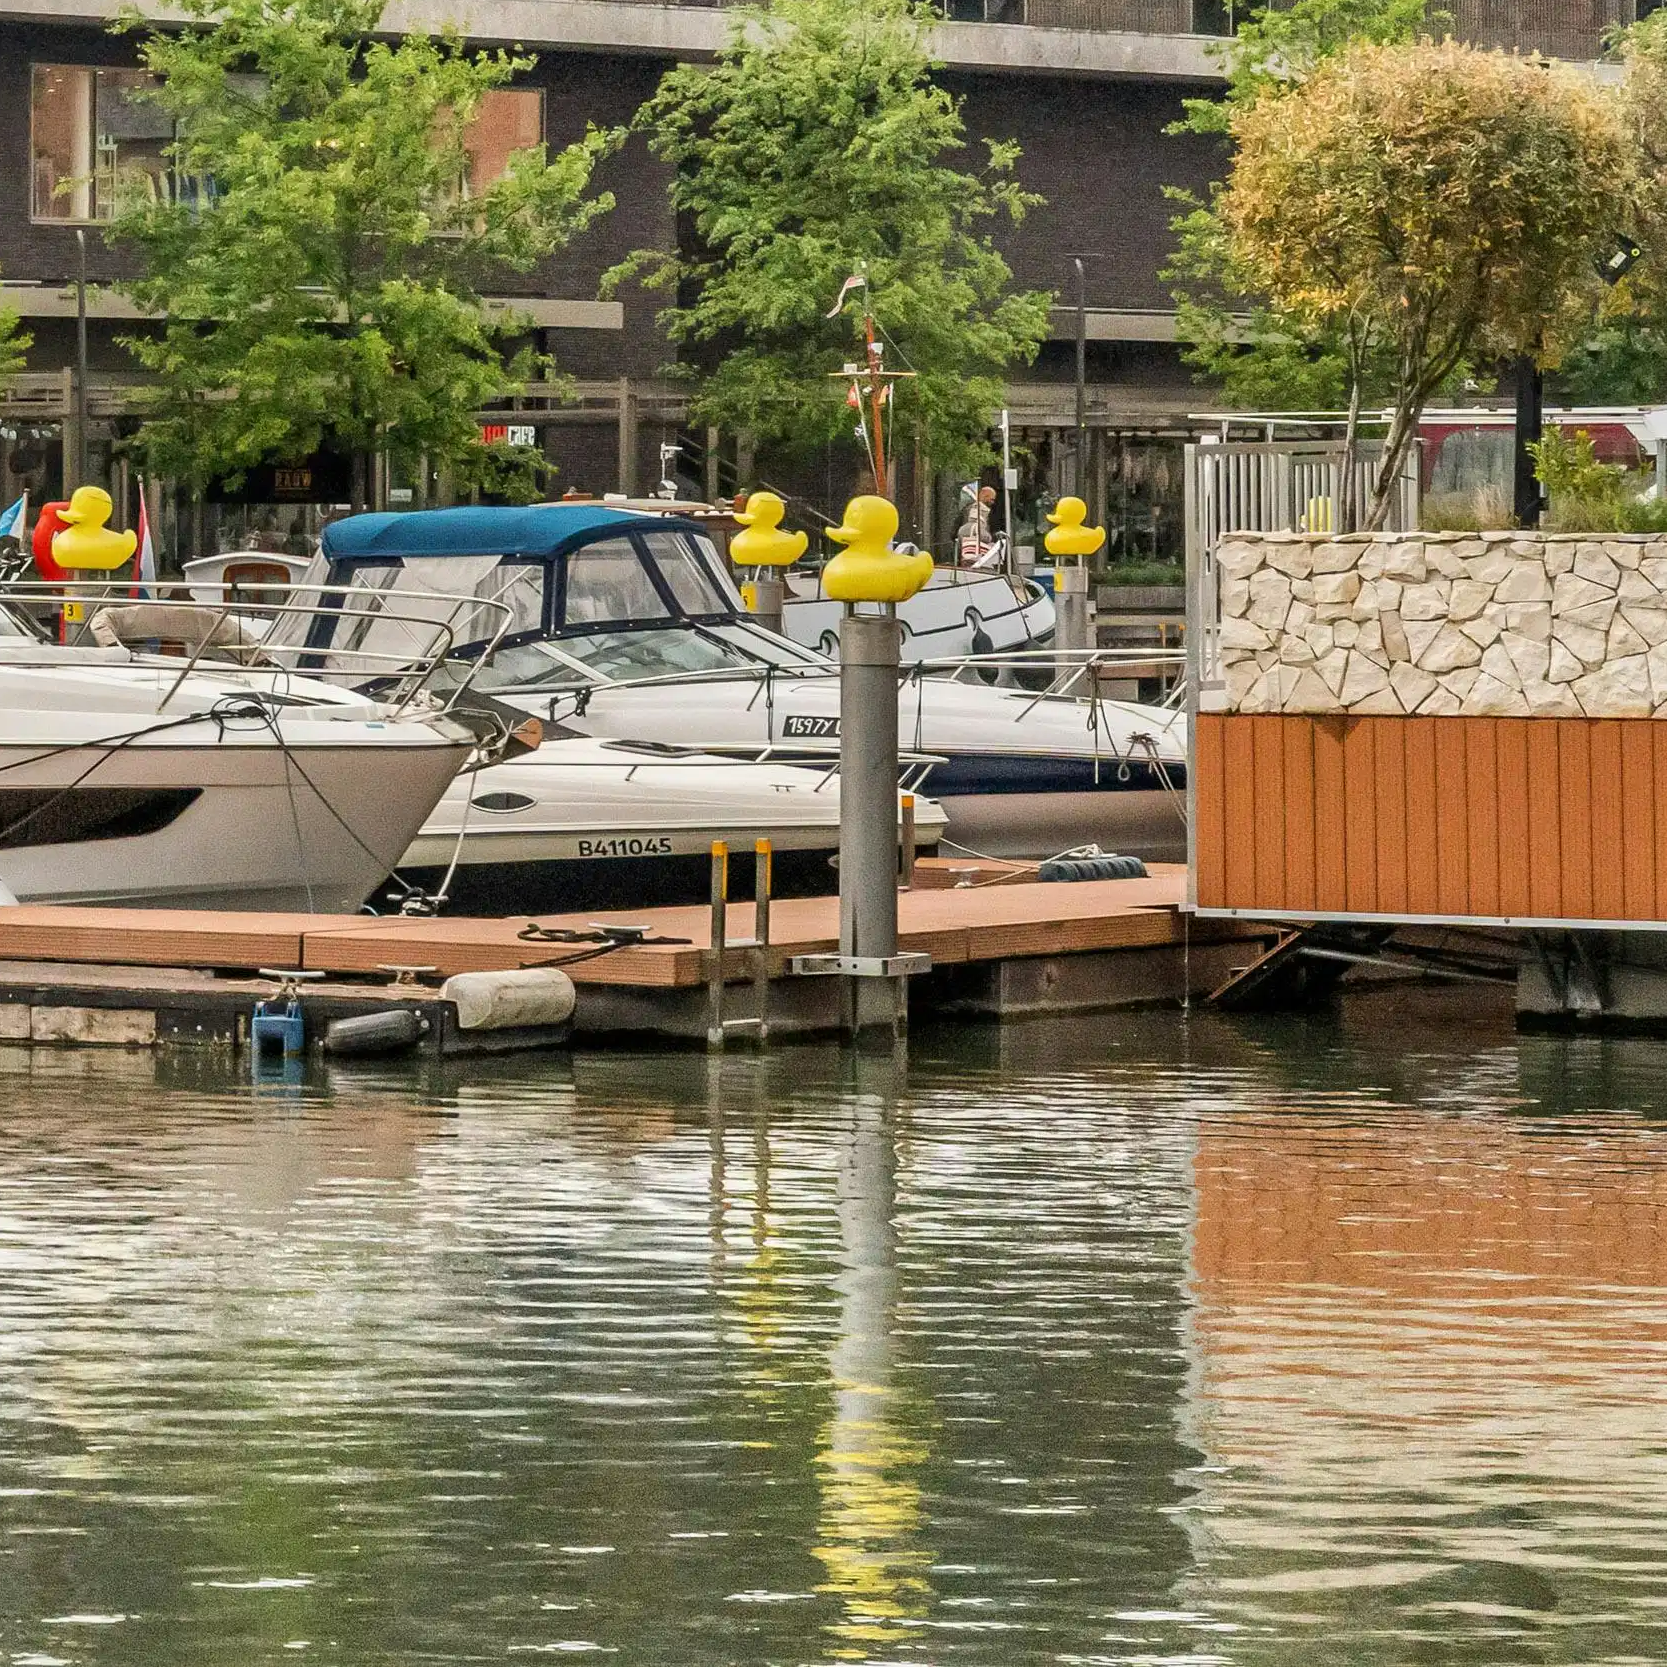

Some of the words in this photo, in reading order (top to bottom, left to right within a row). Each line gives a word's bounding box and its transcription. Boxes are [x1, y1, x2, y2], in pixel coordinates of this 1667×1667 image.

[67, 604, 74, 617] 3
[788, 717, 834, 735] 1597Y
[578, 837, 672, 857] B411045
